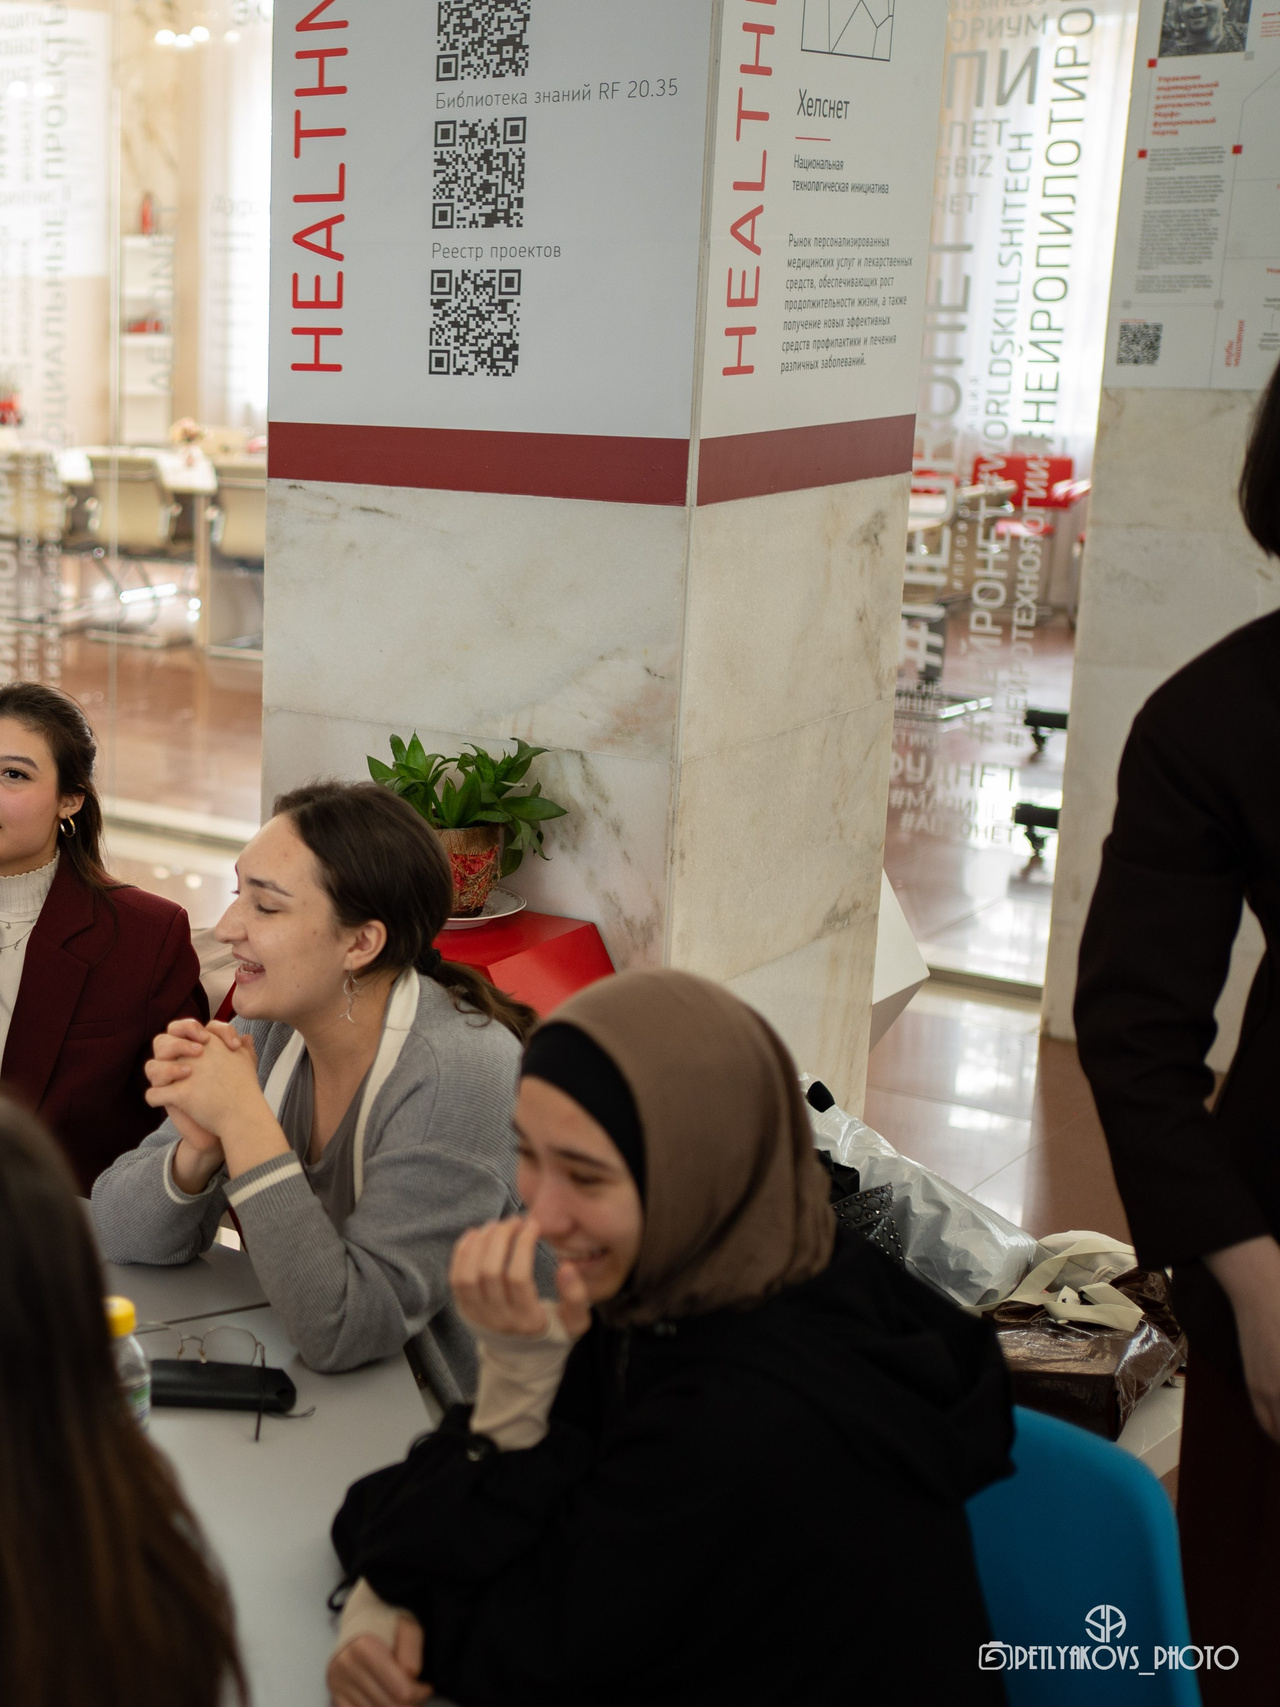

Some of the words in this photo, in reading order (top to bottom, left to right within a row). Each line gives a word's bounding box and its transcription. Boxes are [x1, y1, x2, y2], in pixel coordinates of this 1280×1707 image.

[435, 89, 528, 110] Библиотека
[534, 83, 592, 105] знаний
[598, 80, 621, 101] RF
[627, 77, 679, 99] 20.35
[796, 88, 850, 120] Хелснет
[793, 154, 844, 171] Национальная
[722, 0, 777, 376] HEALTH
[792, 180, 849, 193] технологическая
[850, 182, 890, 195] инициатива
[1017, 0, 1096, 455] #НЕЙРОПИЛОТИРО
[788, 233, 812, 248] Рынок
[813, 237, 891, 250] персонализированных
[431, 242, 484, 262] Реестр
[490, 244, 562, 262] проектов
[787, 257, 835, 270] медицинских
[836, 257, 856, 270] услуг
[857, 257, 862, 268] и
[863, 257, 913, 270] лекарственных
[785, 278, 817, 292] средств,
[818, 274, 878, 289] обеспечивающих
[880, 277, 895, 289] рост
[784, 298, 856, 313] продолжительности
[857, 297, 880, 309] жизни,
[882, 296, 887, 307] а
[888, 296, 908, 307] также
[977, 131, 1034, 492] #WORLDSKILLSHITECH
[782, 319, 822, 333] получение
[823, 318, 845, 329] новых
[846, 316, 891, 330] эффективных
[781, 339, 811, 354] средств
[812, 337, 862, 352] профилактики
[863, 336, 869, 346] и
[869, 334, 897, 346] лечения
[780, 360, 819, 376] различных
[820, 353, 867, 370] заболеваний.
